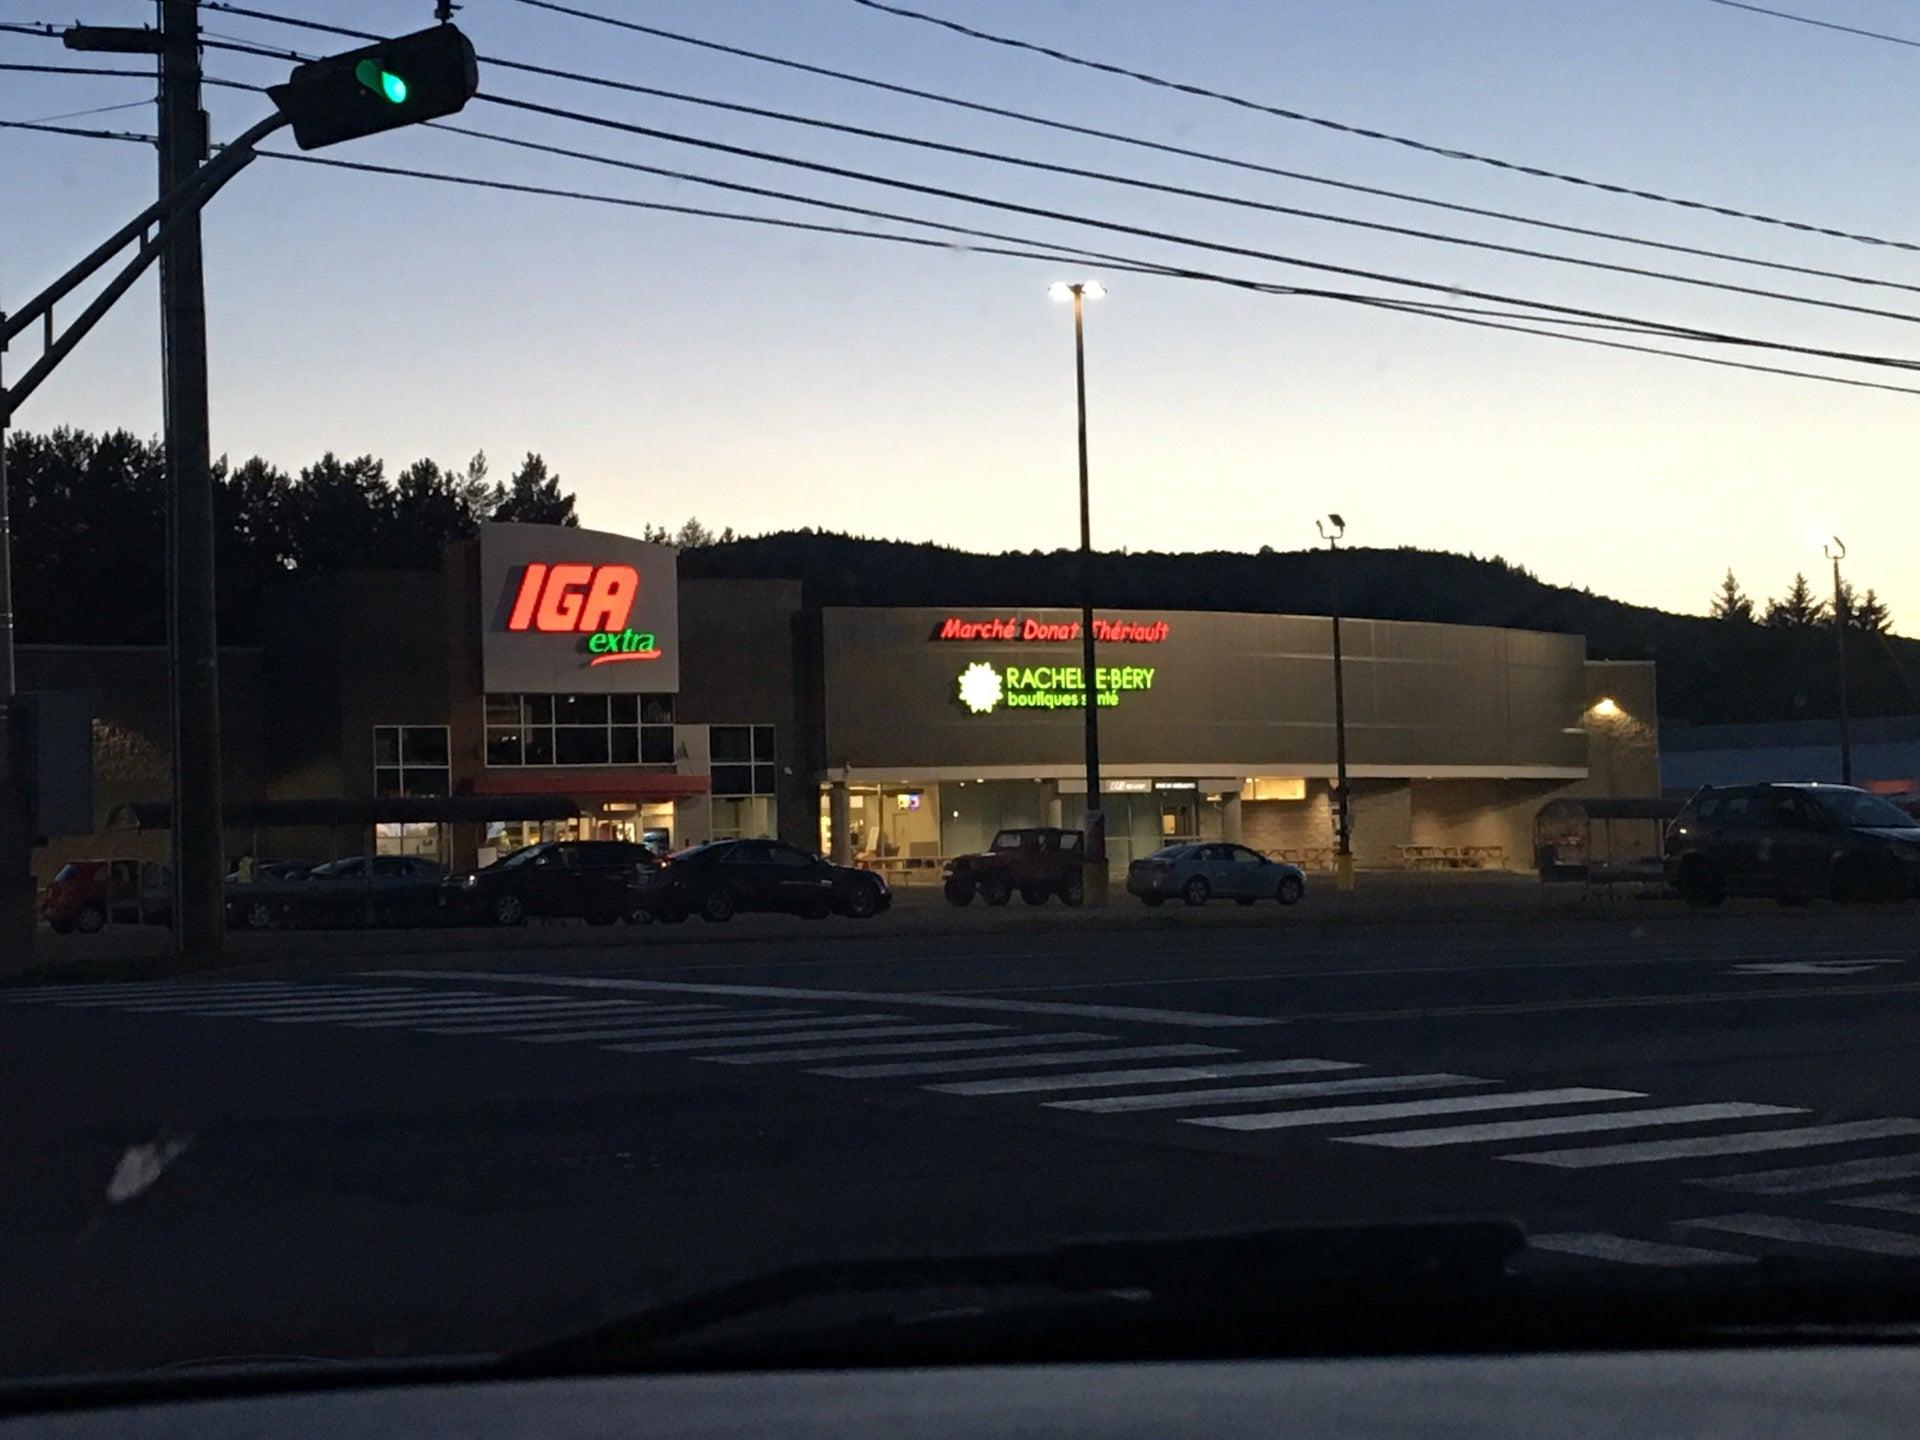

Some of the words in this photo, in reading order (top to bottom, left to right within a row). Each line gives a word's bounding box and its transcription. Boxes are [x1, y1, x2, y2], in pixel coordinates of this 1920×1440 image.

[509, 563, 639, 632] IGA
[940, 617, 1017, 640] Marché
[1023, 618, 1080, 640] Donat
[588, 629, 656, 653] extra
[1007, 691, 1079, 710] boutiques
[1080, 690, 1120, 707] snté
